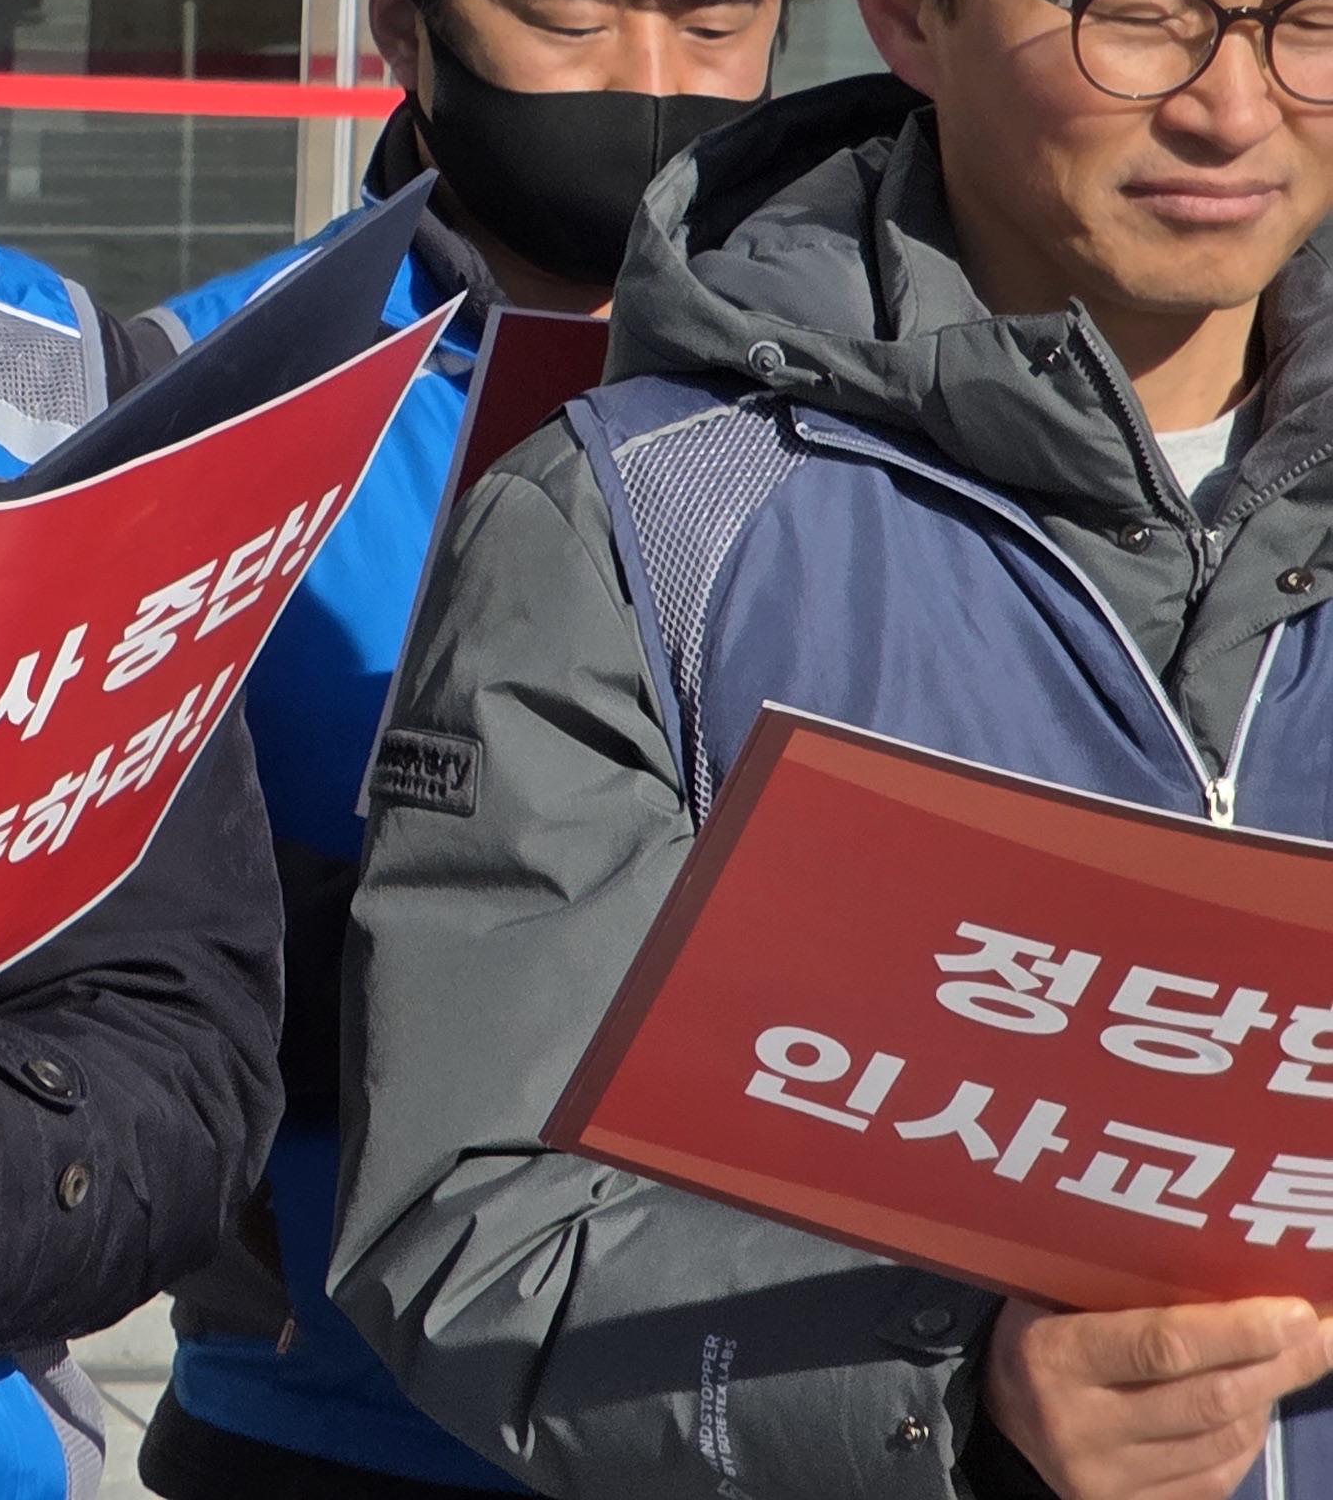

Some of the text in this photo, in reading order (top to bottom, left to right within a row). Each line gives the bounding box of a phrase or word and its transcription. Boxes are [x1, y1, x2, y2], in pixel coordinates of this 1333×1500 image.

[103, 483, 342, 692] 중단!
[699, 1334, 721, 1473] NDSTOPPER
[718, 1338, 738, 1384] LABS
[720, 1455, 737, 1477] BY
